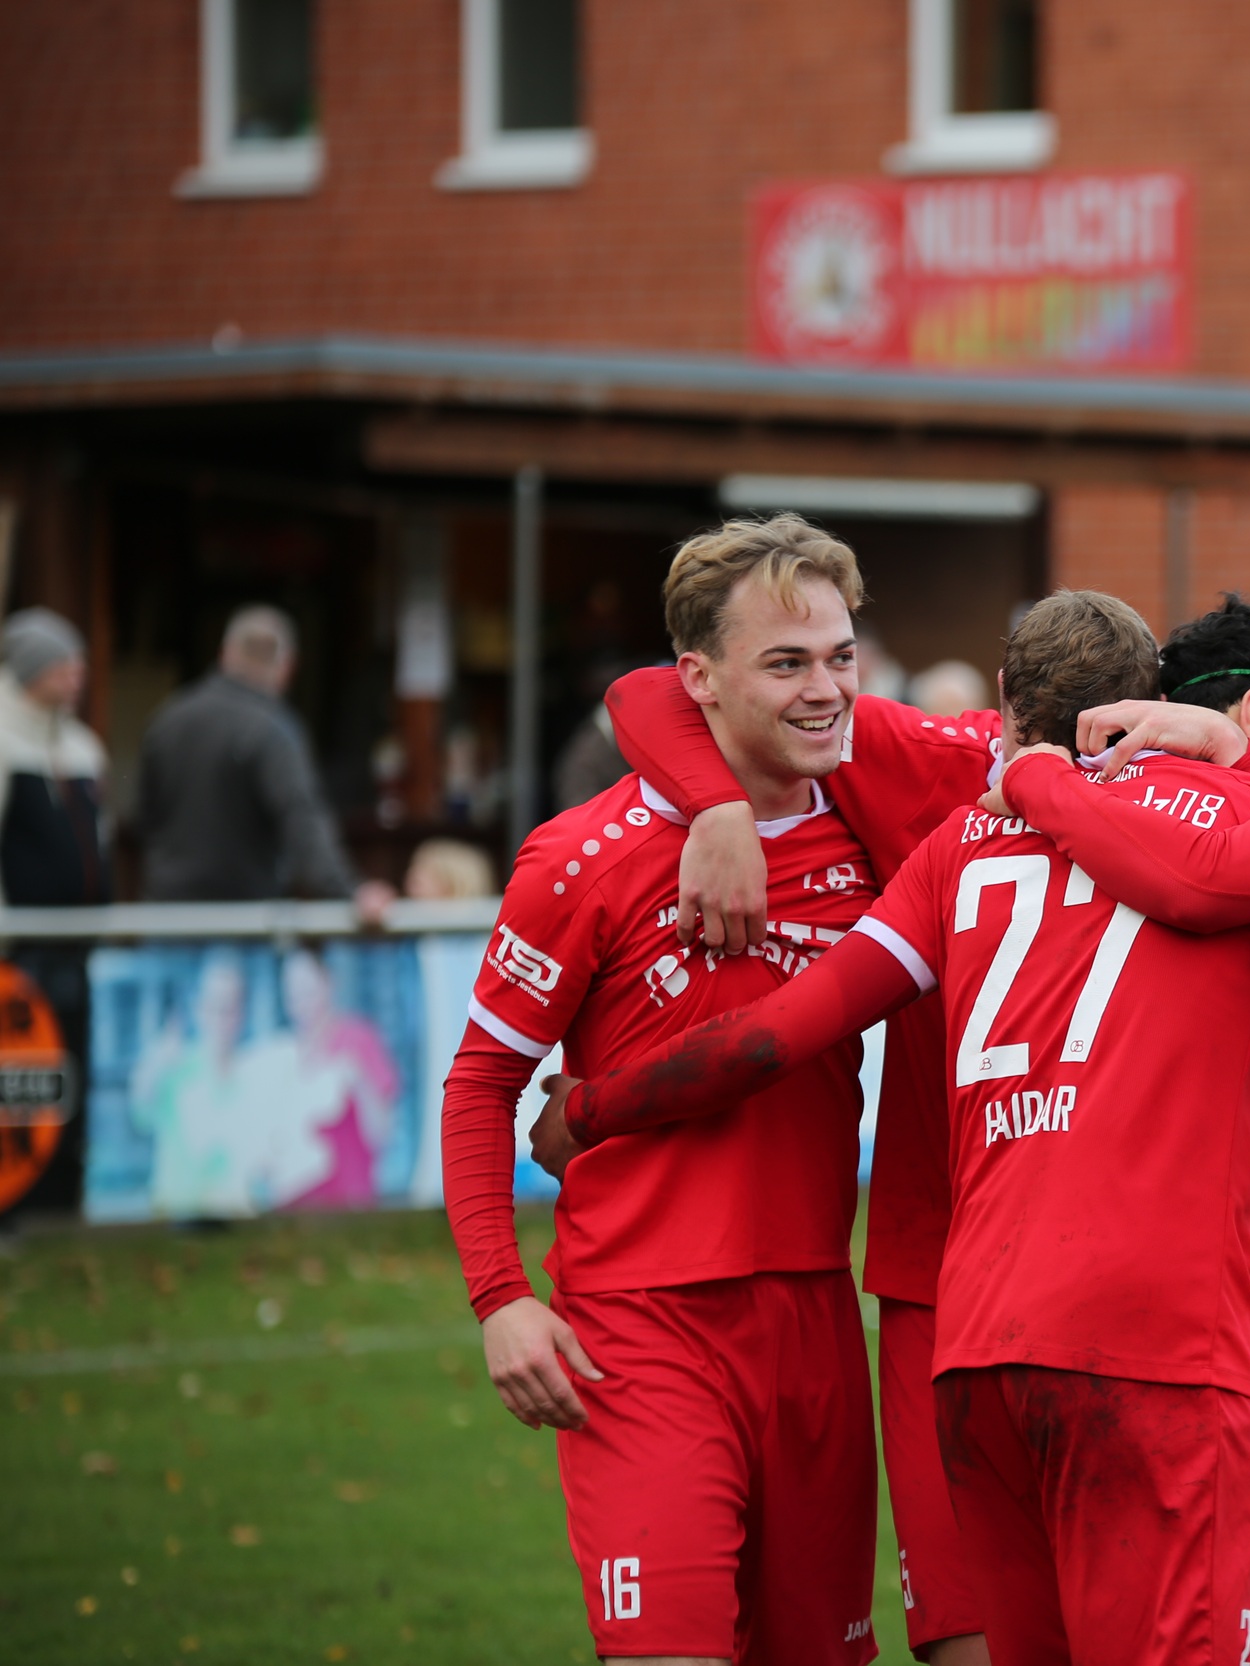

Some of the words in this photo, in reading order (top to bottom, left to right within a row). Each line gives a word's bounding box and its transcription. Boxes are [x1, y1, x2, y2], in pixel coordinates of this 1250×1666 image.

[486, 952, 498, 970] Team
[497, 964, 516, 985] Sports
[516, 980, 550, 1007] Jesteburg
[954, 854, 1147, 1088] 27
[985, 1085, 1077, 1149] HAIDAR
[599, 1557, 641, 1621] 16
